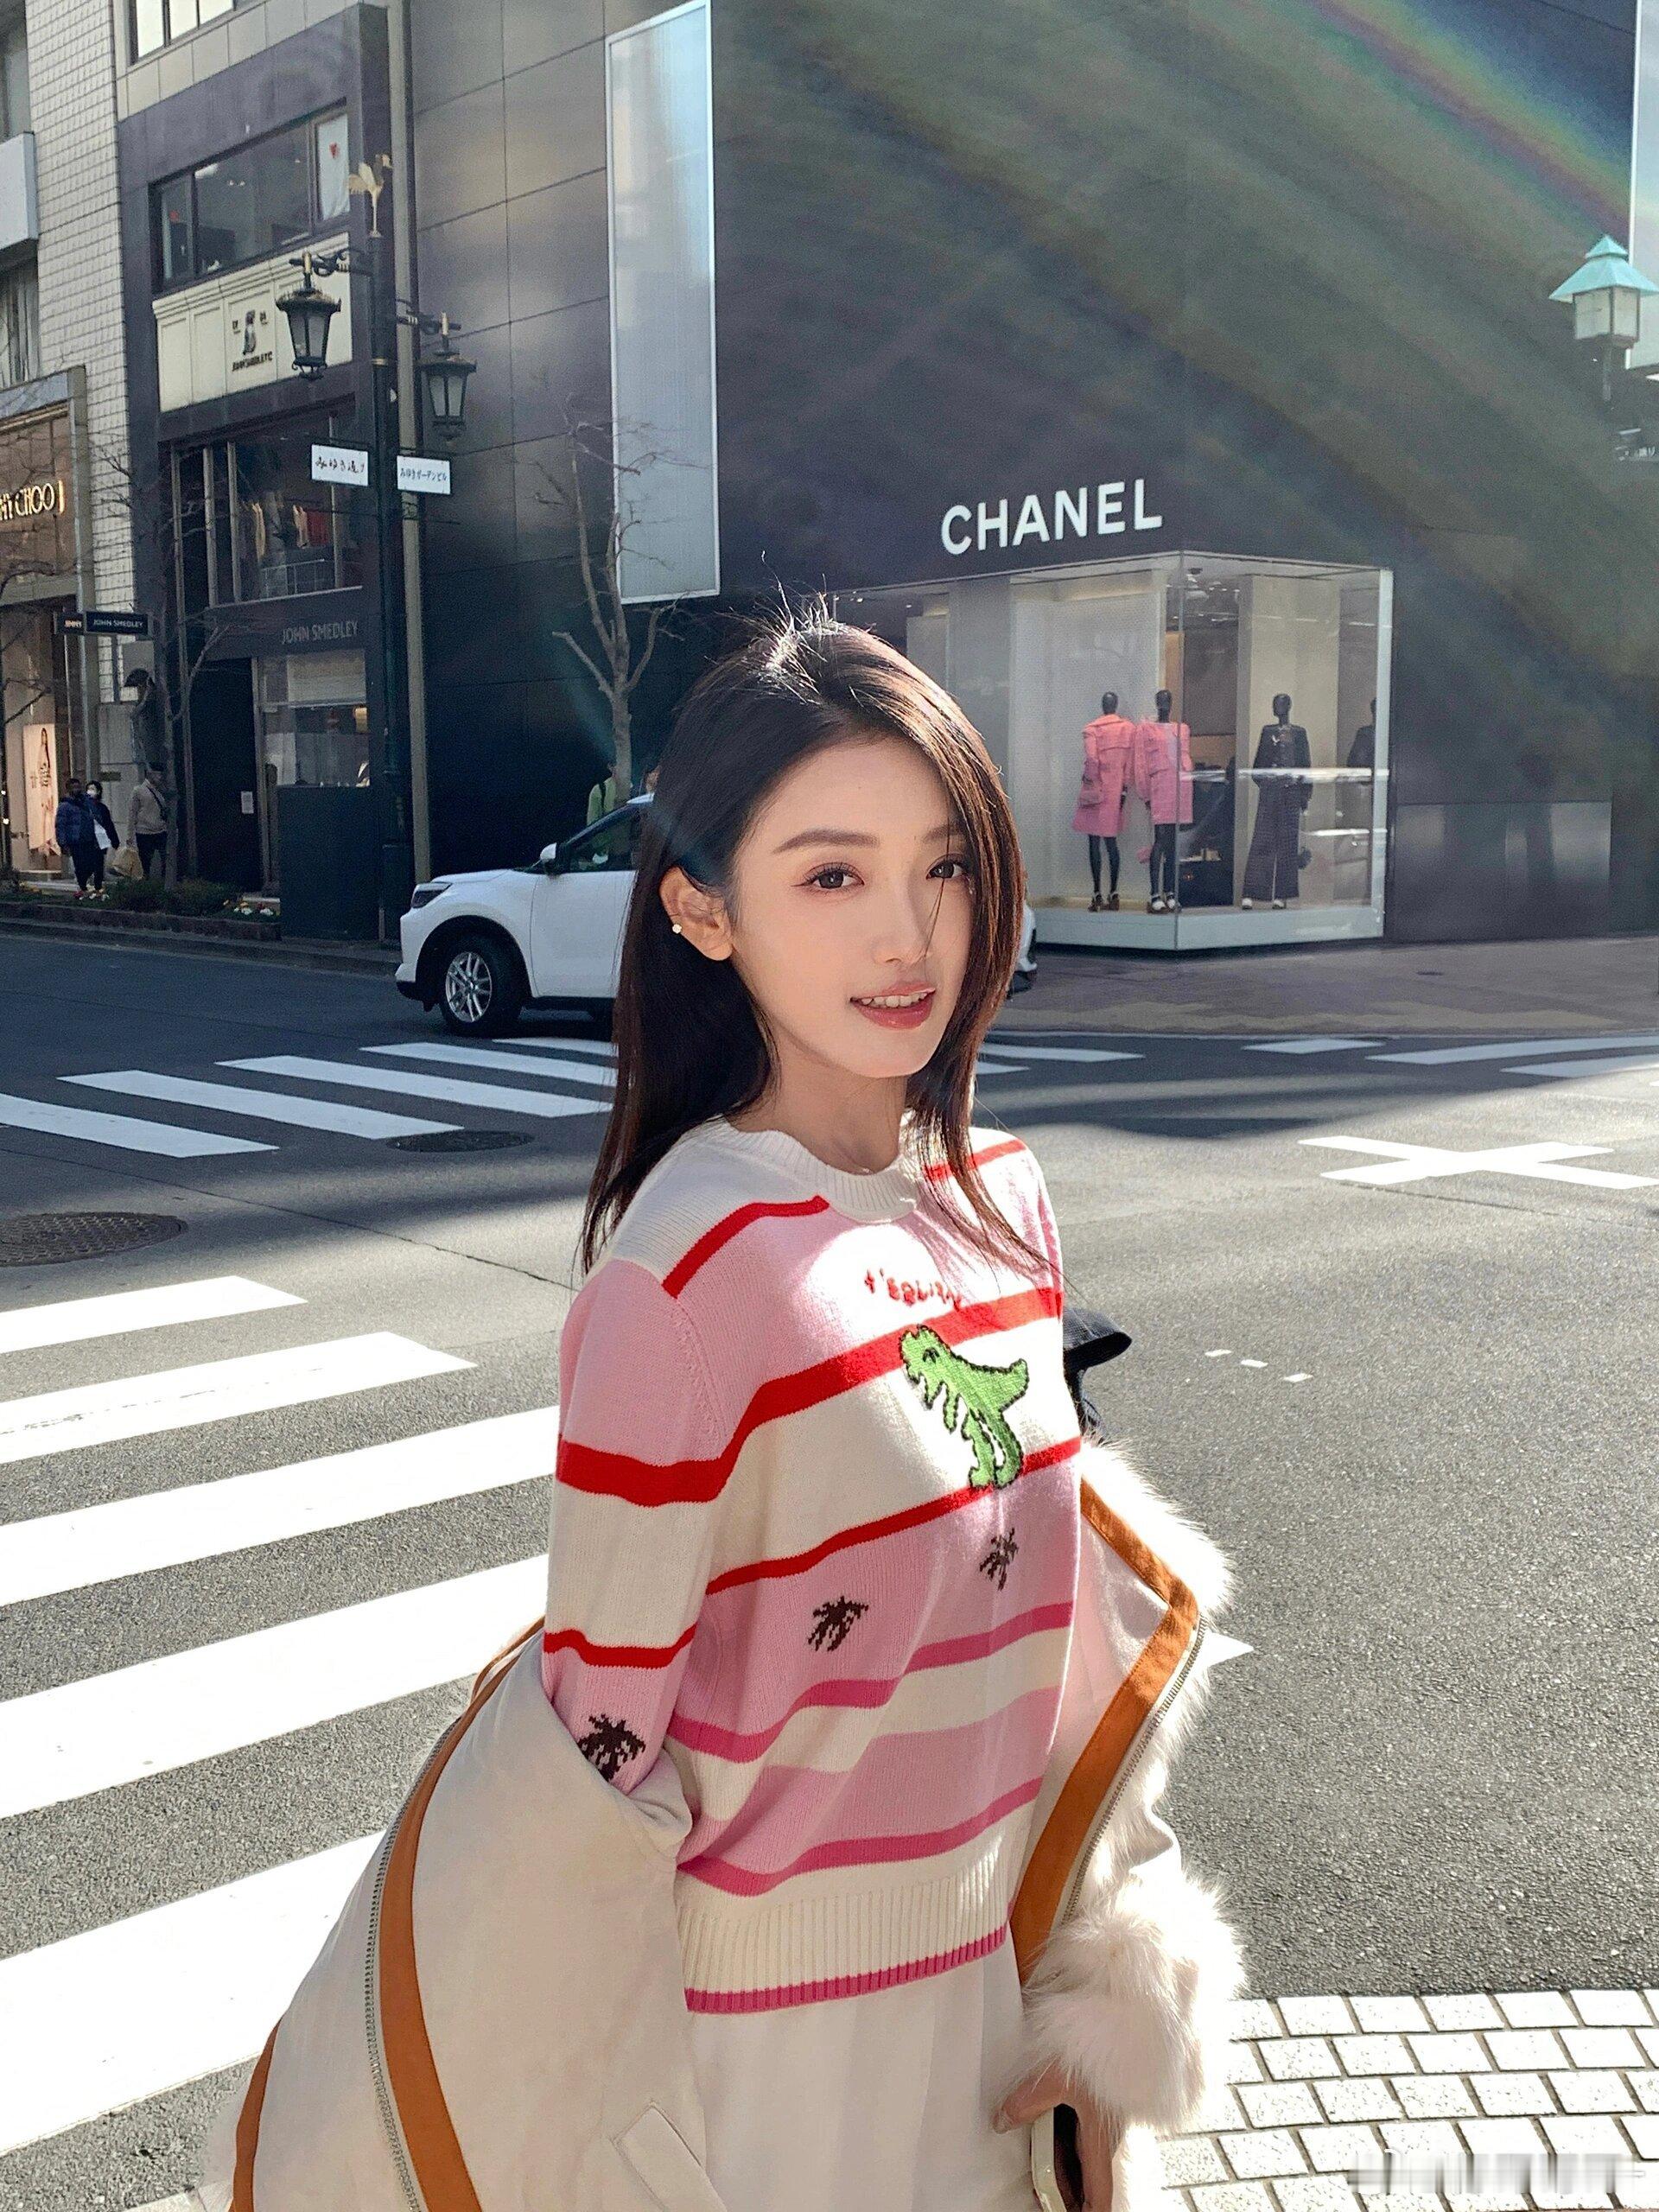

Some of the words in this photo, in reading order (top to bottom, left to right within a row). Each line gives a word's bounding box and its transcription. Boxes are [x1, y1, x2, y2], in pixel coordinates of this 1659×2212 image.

[941, 479, 1163, 555] CHANEL
[282, 626, 309, 645] JOHN
[312, 620, 359, 640] SMEDLEY
